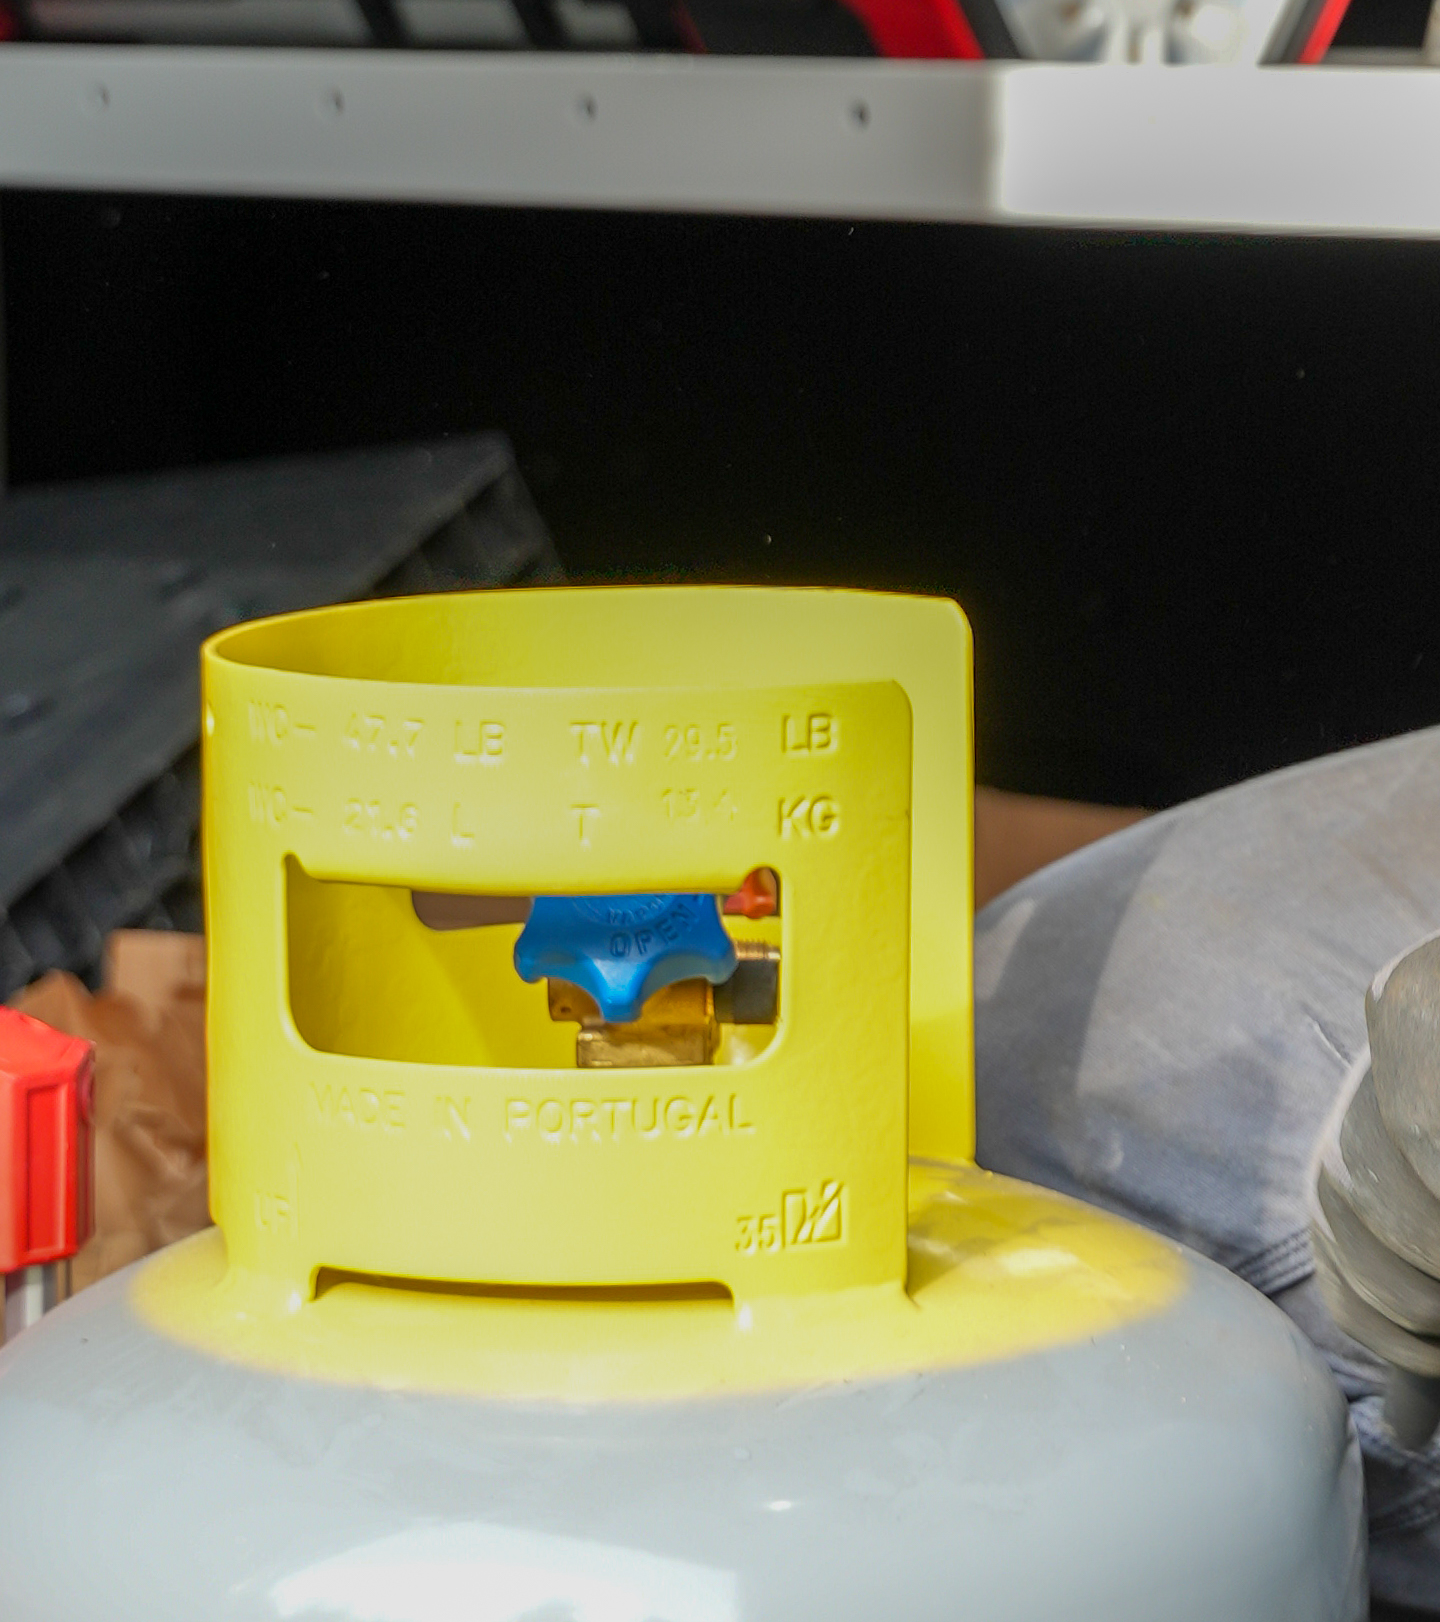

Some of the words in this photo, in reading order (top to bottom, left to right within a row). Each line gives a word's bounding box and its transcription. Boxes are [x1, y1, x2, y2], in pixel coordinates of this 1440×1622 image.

[453, 719, 505, 767] LB
[569, 719, 641, 767] TW
[780, 712, 838, 756] LB
[451, 801, 476, 846] L
[569, 802, 600, 850] T
[777, 794, 840, 840] KG
[504, 1092, 757, 1146] PORTUGAL
